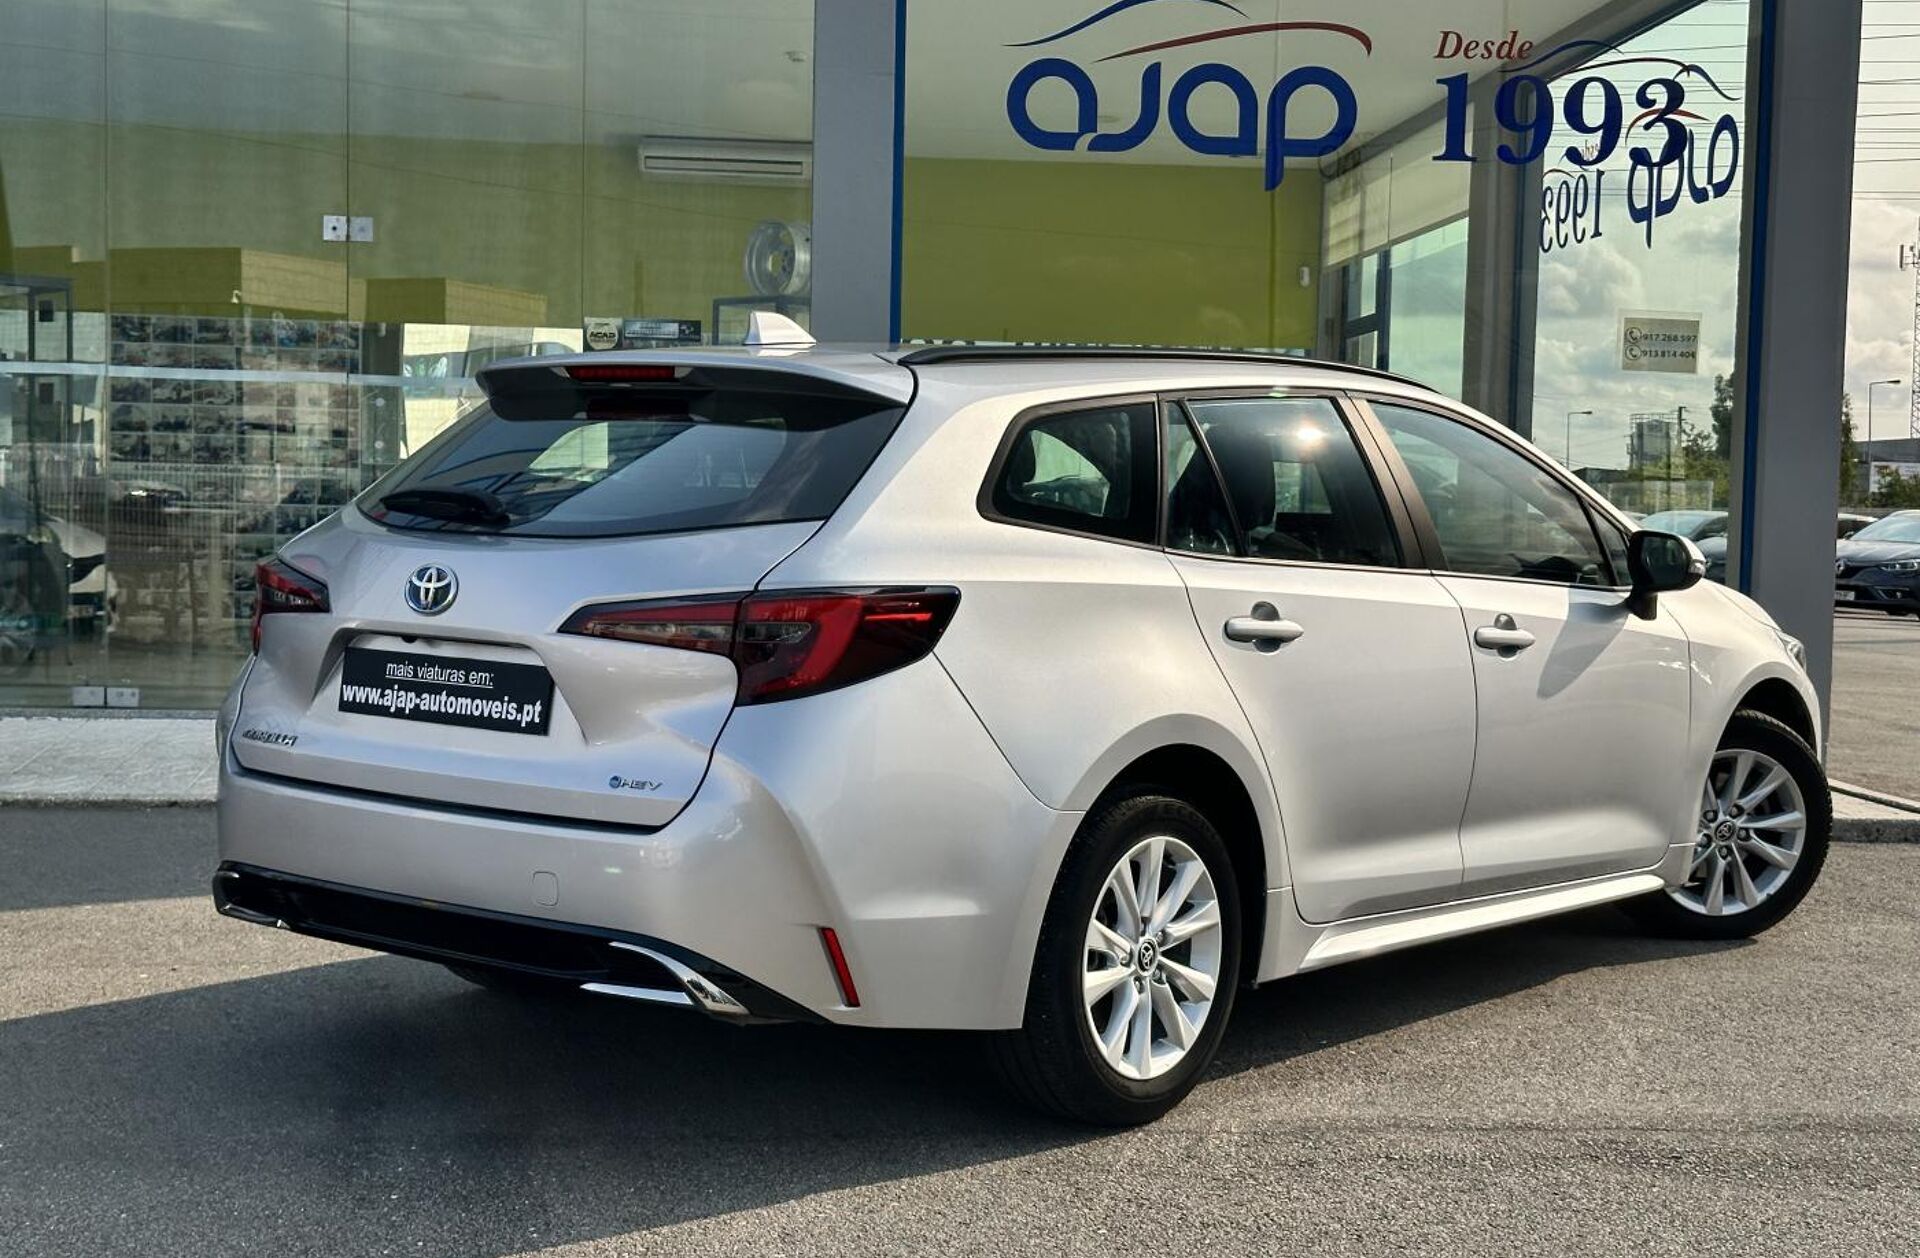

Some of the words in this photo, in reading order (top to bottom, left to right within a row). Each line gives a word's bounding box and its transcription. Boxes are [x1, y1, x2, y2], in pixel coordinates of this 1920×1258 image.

[1434, 30, 1533, 61] Desde
[1432, 72, 1689, 168] 1993
[386, 661, 414, 678] mais
[417, 662, 466, 683] viaturas
[468, 671, 494, 686] em:
[342, 685, 542, 727] www.ajap-automoveis.pt
[621, 779, 663, 791] HEV
